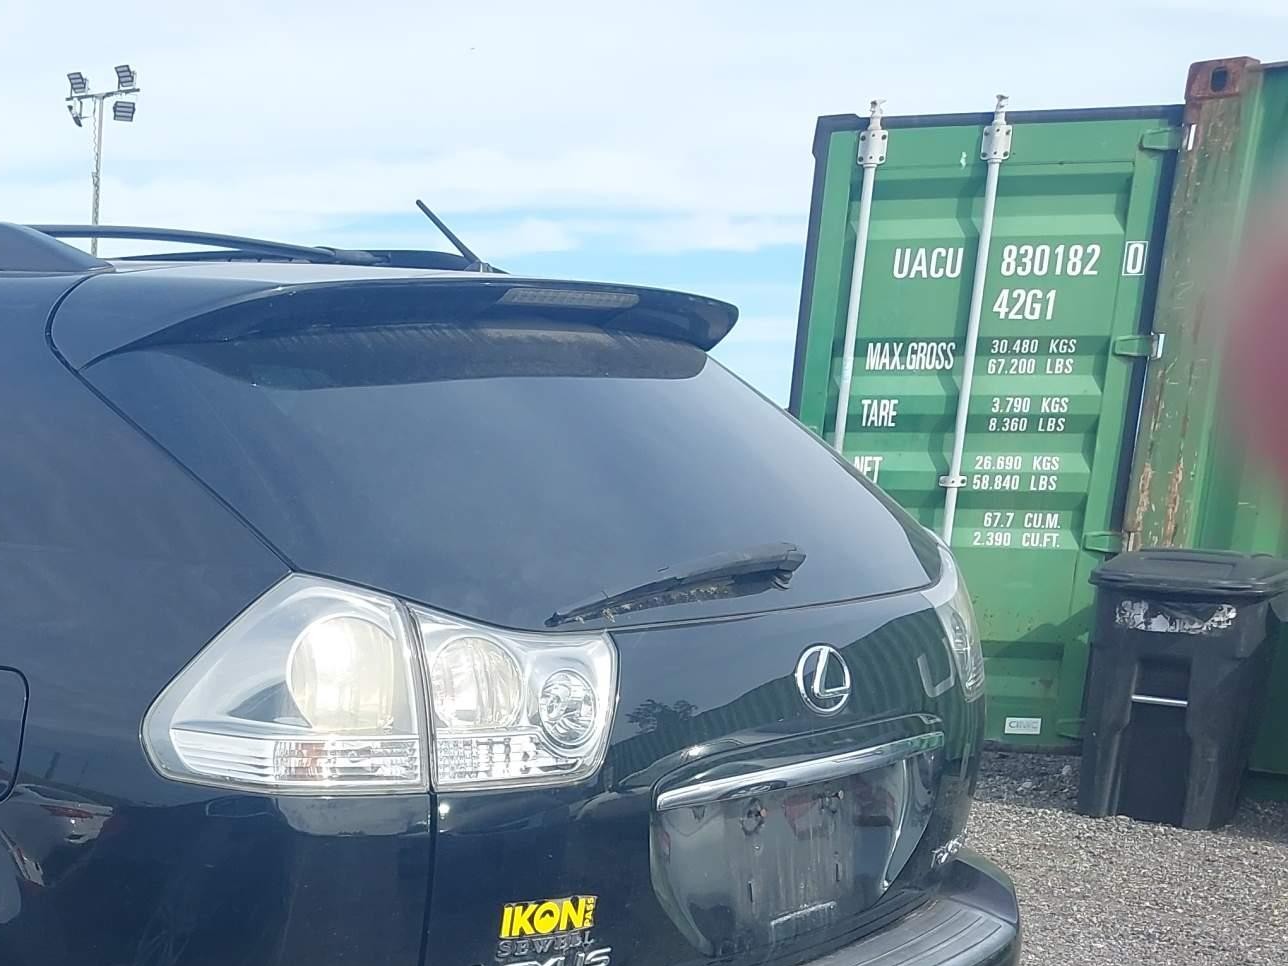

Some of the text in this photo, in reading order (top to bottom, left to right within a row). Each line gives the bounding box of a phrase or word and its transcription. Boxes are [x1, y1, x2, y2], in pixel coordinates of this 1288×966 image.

[893, 247, 964, 278] UACU
[1000, 243, 1101, 276] 830182
[992, 289, 1057, 320] 42G1
[865, 339, 1077, 370] MAX.GROSS 30.480 KGS
[987, 358, 1074, 374] 67.200 LBS
[861, 397, 1070, 427] TARE 3.790 KGS
[988, 417, 1066, 432] 8.360 LBS
[974, 455, 1023, 470] 26.690
[1032, 456, 1060, 471] KGS
[972, 475, 1057, 491] 58.840 LBS
[983, 512, 1061, 529] 67.7 CU.M.
[973, 532, 1012, 547] 2.390
[501, 896, 595, 938] IKON PASS
